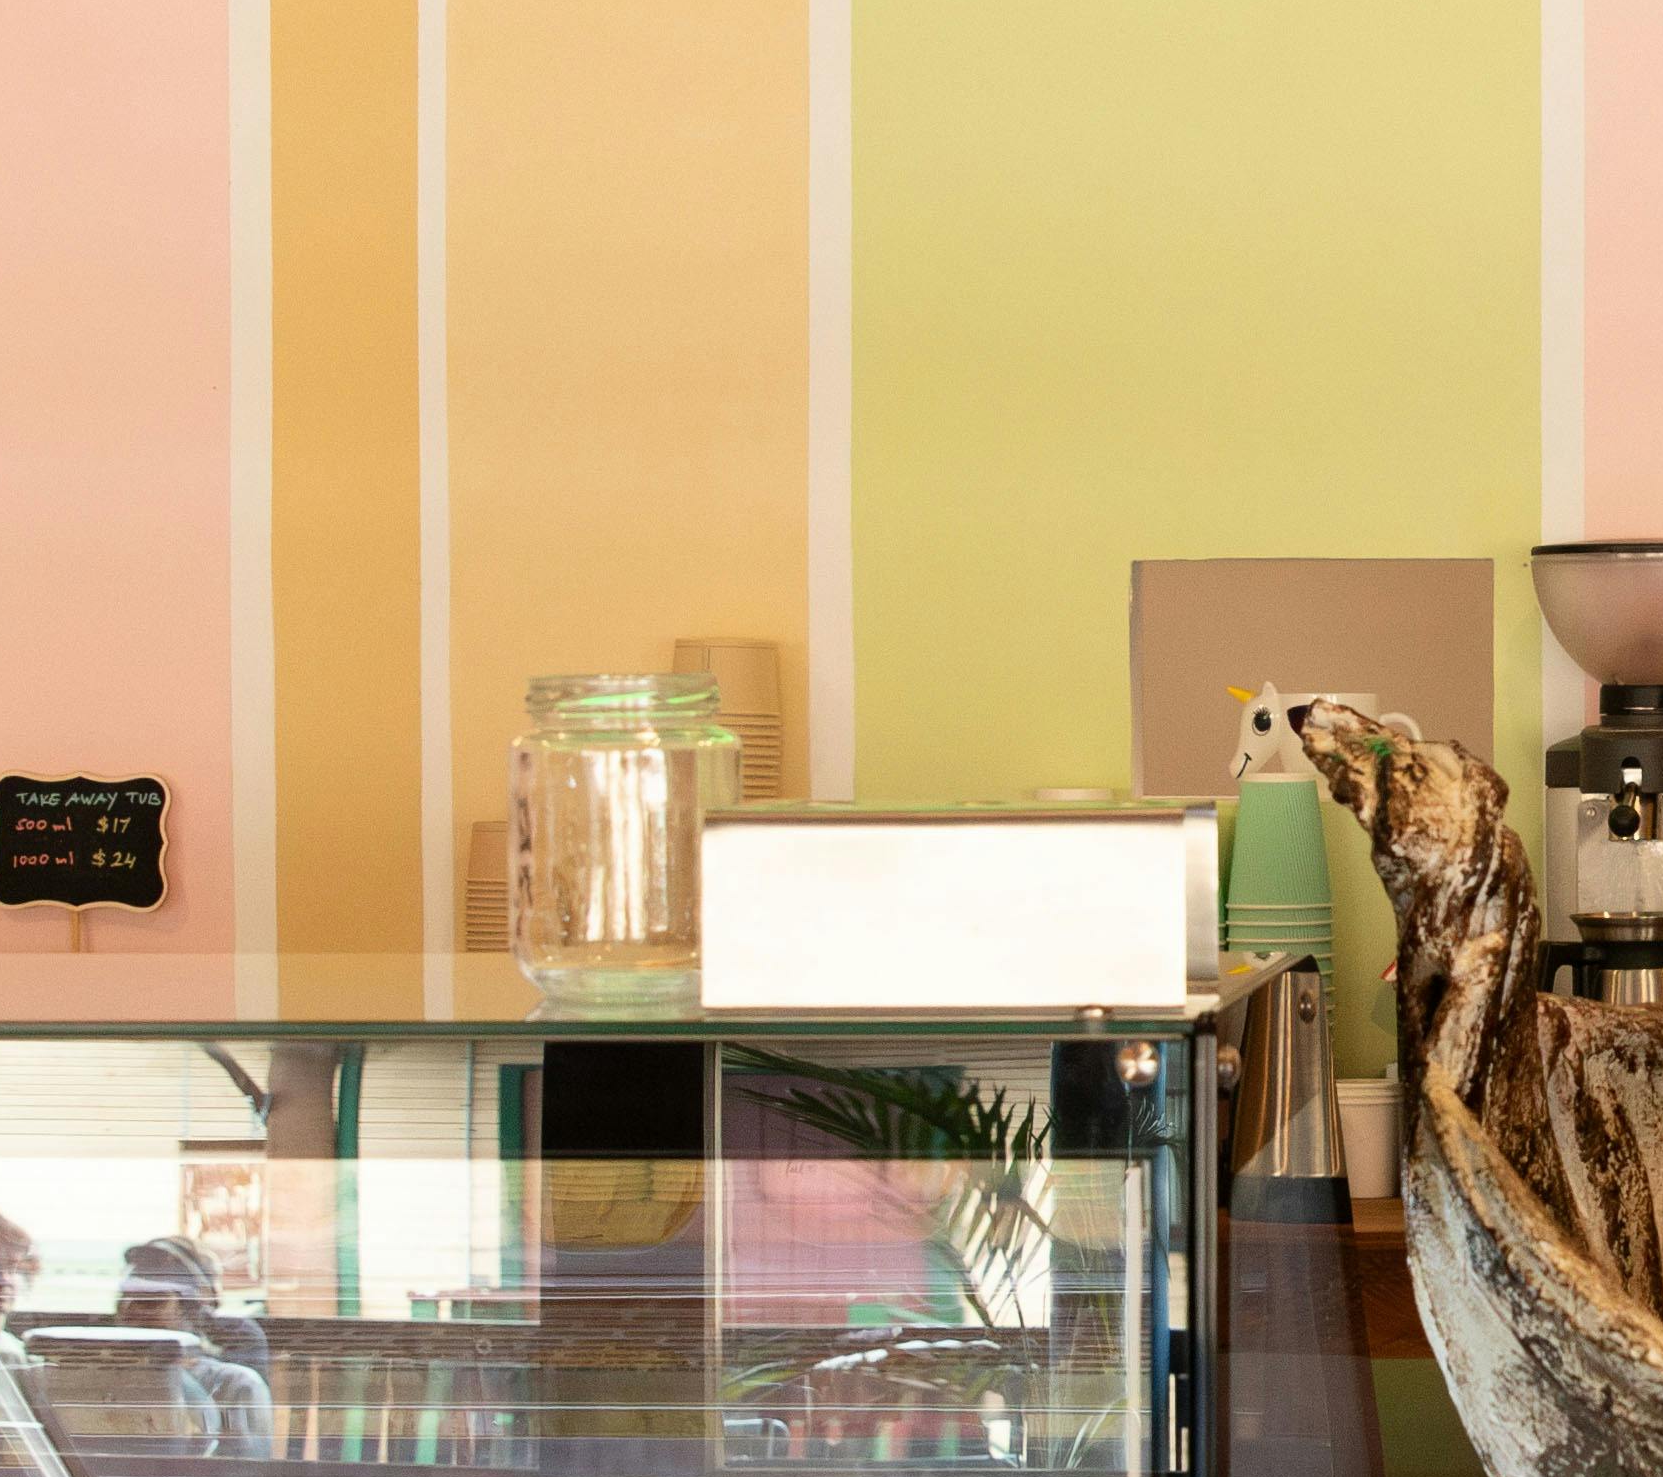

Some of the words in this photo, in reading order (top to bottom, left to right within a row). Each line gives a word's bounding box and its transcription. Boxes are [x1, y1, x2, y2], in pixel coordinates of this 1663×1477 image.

[15, 792, 61, 807] TAKE
[65, 791, 119, 811] AWAY
[125, 791, 162, 807] TUB
[15, 818, 48, 832] 500
[52, 815, 73, 832] ml
[95, 814, 131, 834] $17
[13, 854, 50, 869] 1000
[55, 850, 74, 866] ml
